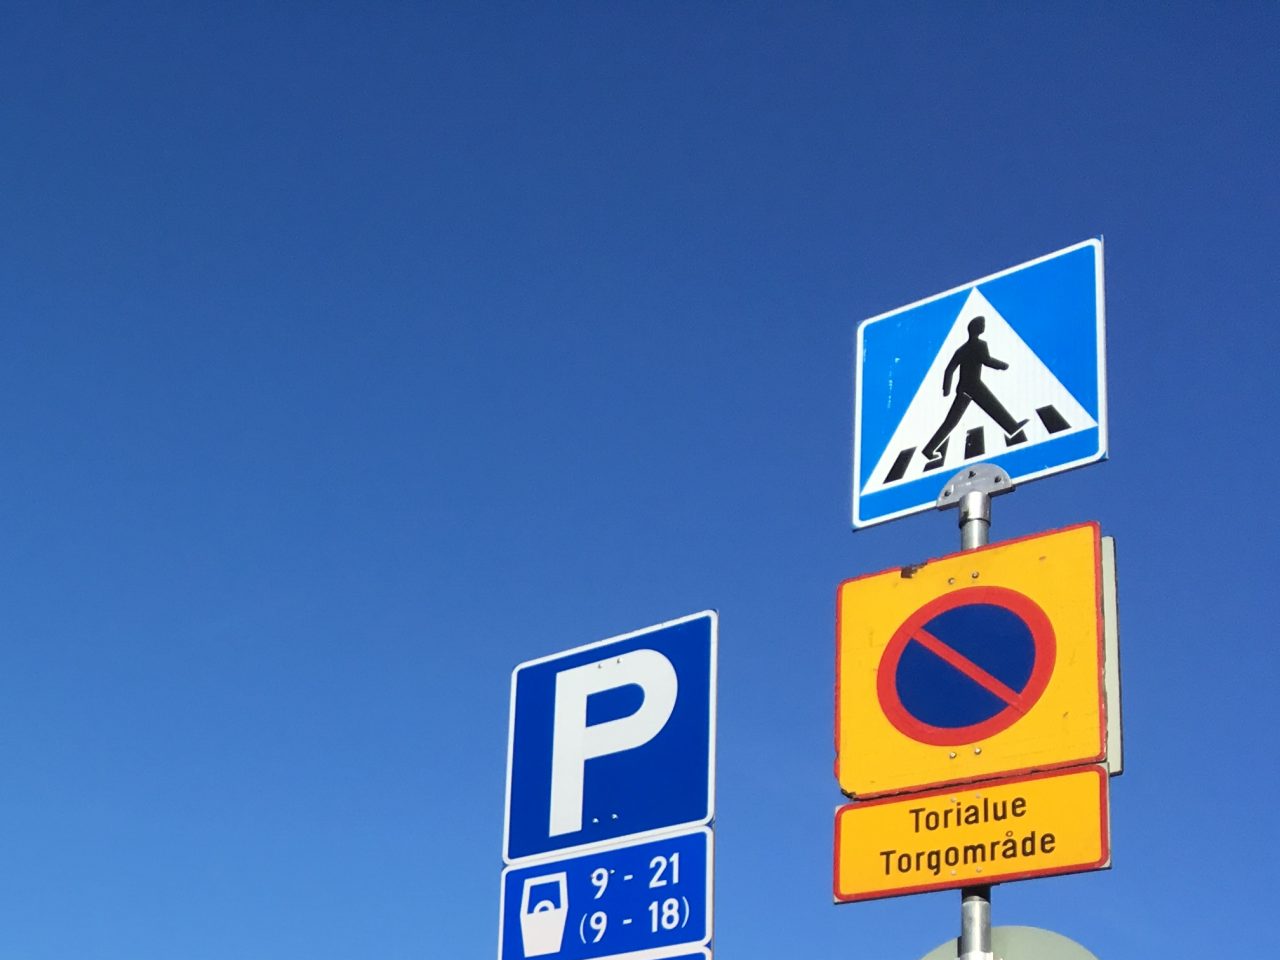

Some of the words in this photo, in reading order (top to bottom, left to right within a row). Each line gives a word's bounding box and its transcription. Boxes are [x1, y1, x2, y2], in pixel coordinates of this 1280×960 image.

[549, 649, 678, 837] P
[909, 797, 1027, 833] Torialue
[591, 867, 609, 899] 9
[649, 852, 679, 888] 21
[880, 830, 1057, 876] Torgområde
[579, 911, 608, 944] (9
[648, 896, 690, 933] 18)
